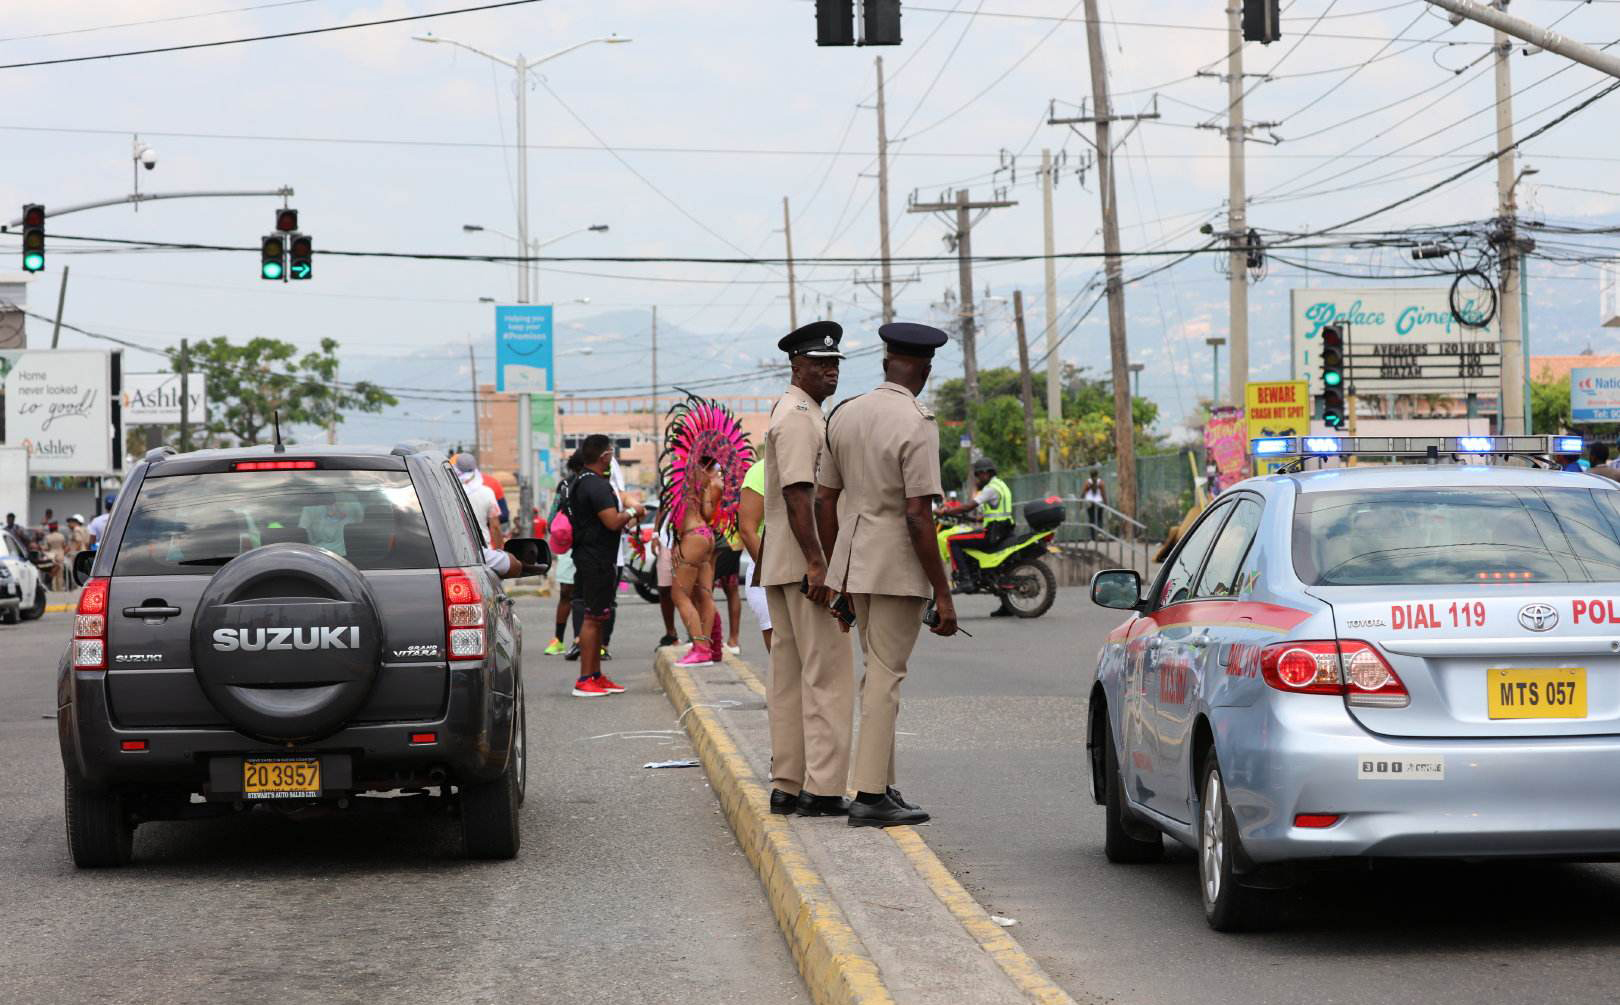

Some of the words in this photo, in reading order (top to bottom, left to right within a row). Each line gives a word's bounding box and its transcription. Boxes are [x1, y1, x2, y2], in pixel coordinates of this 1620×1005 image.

[1305, 299, 1385, 340] Palace
[1373, 343, 1428, 354] AVENGERS
[18, 372, 47, 381] Home
[18, 386, 44, 395] never
[46, 384, 78, 395] looked
[1257, 385, 1297, 404] BEWARE
[131, 387, 200, 413] Ashly
[1250, 406, 1271, 420] CRASH
[1273, 406, 1286, 419] HOT
[1287, 405, 1305, 418] SPOT
[35, 440, 76, 456] Ashley
[1346, 619, 1386, 629] TOYOTA
[1391, 604, 1442, 630] DIAL
[1448, 602, 1486, 628] 119
[212, 626, 360, 652] SUZUKI
[115, 654, 163, 663] SUZUKI
[392, 650, 438, 658] VITARA
[1500, 682, 1540, 706] MTS
[1545, 681, 1577, 705] 057
[246, 766, 269, 787] 20
[272, 765, 318, 787] 3957
